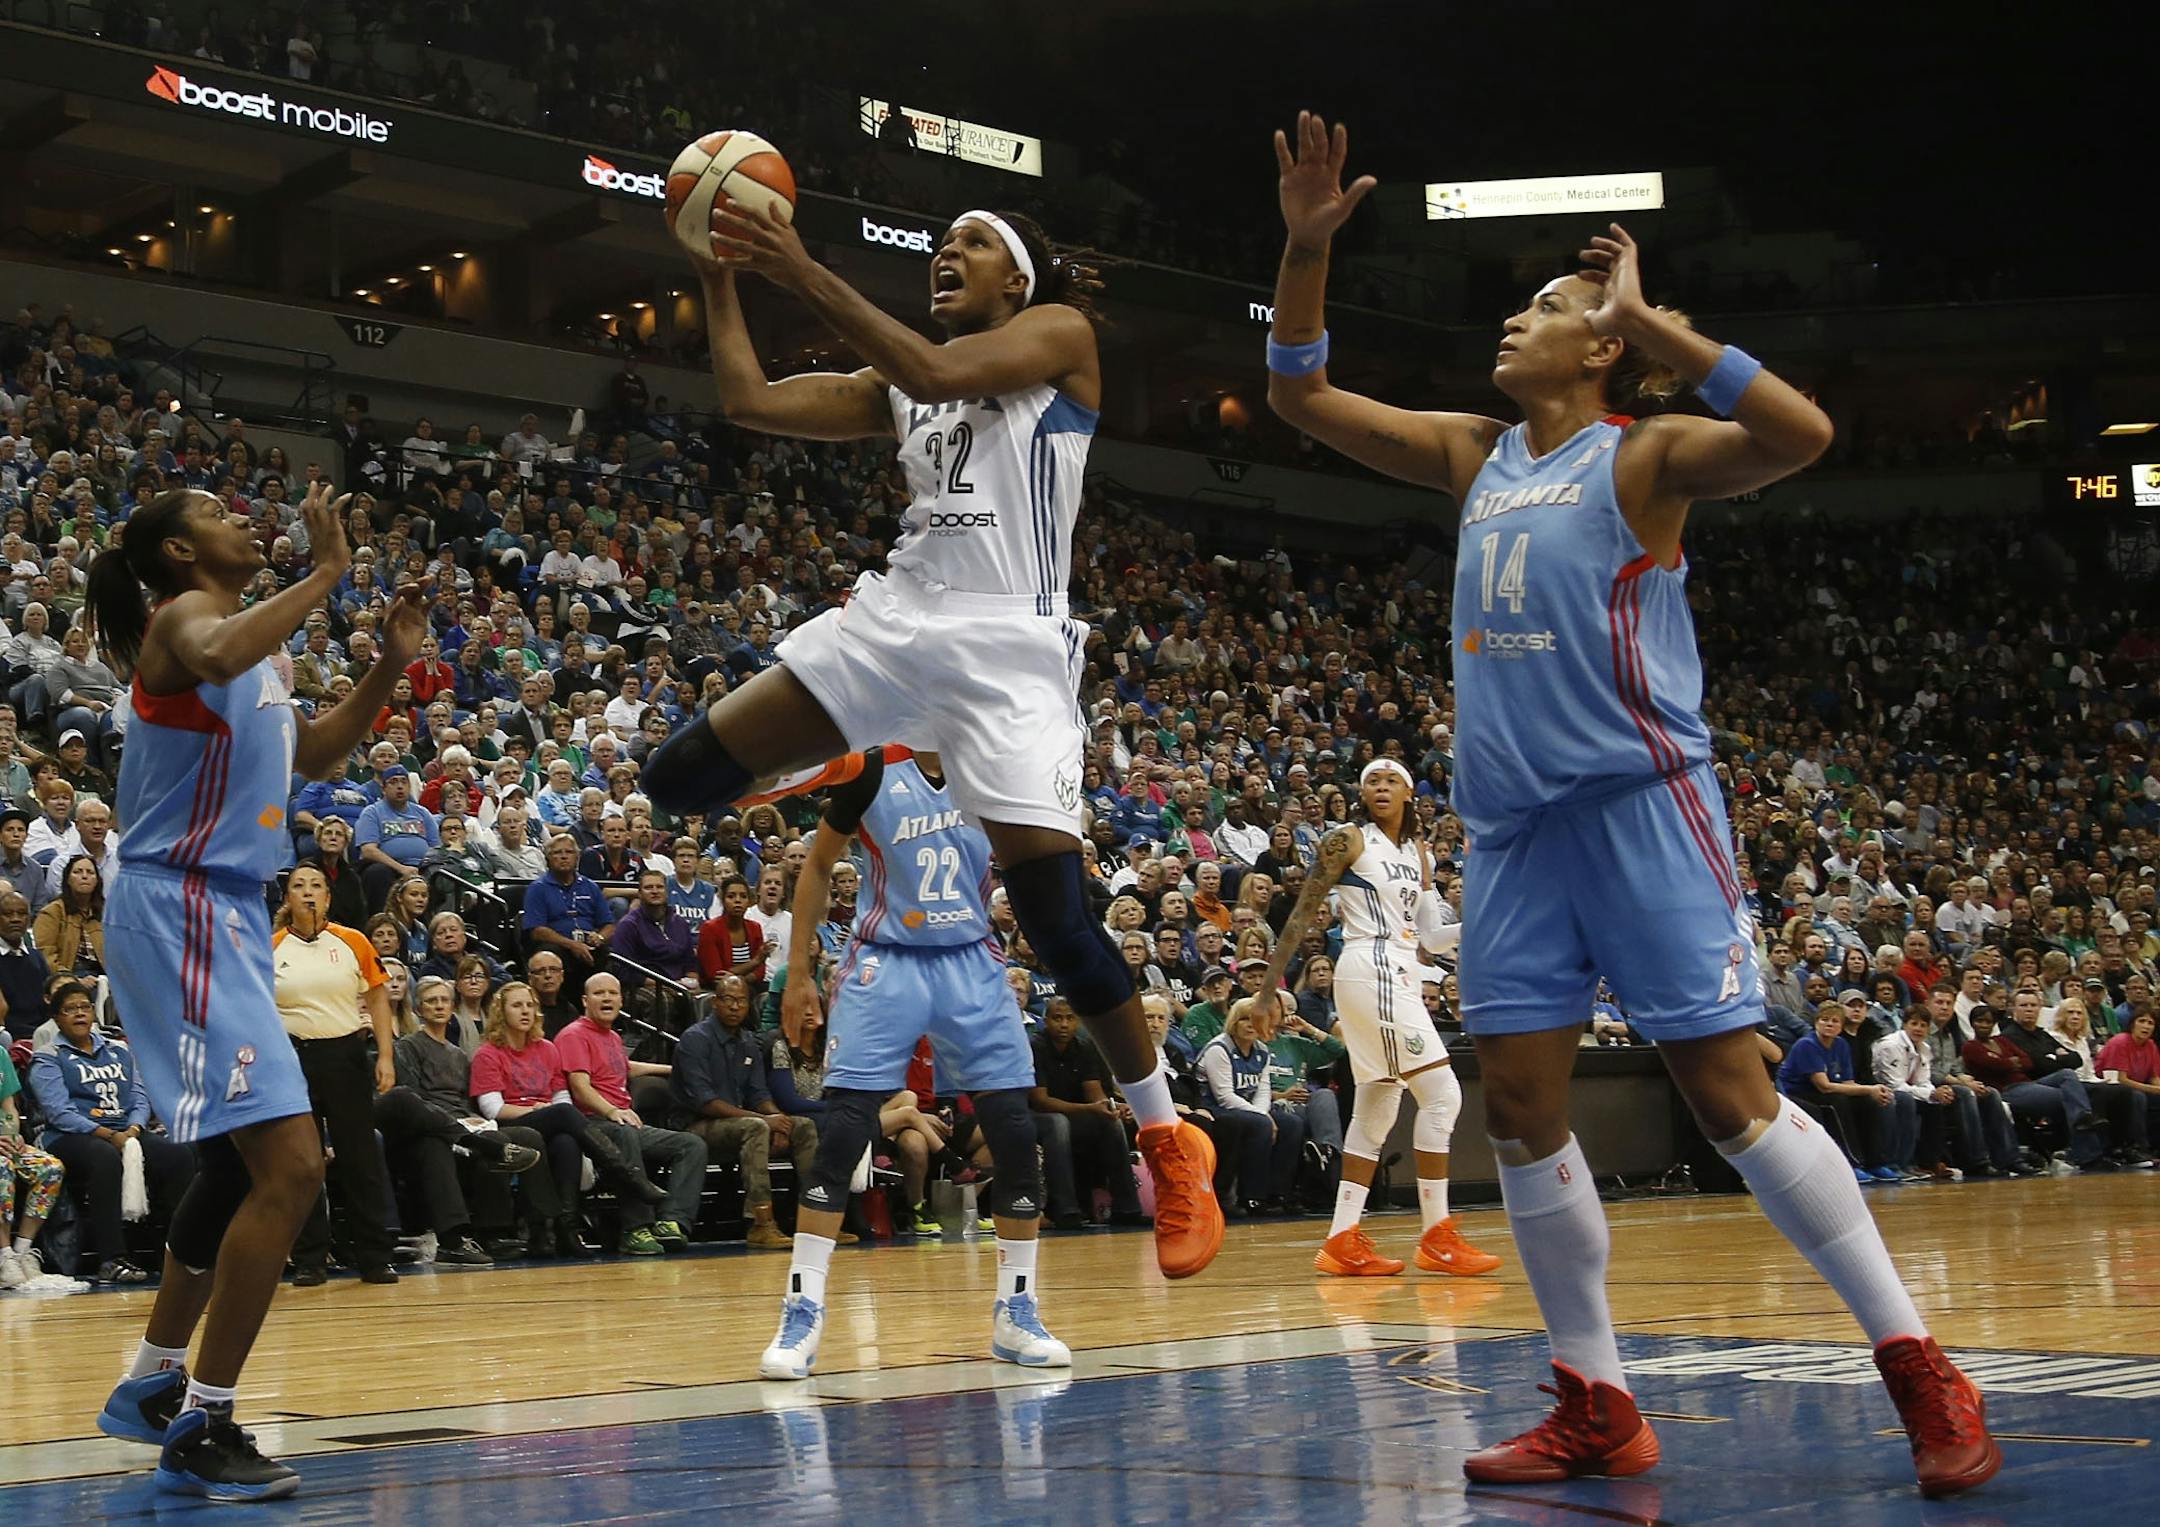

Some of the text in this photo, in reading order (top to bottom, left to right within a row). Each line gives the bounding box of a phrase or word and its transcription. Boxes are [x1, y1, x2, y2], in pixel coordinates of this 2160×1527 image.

[179, 76, 389, 143] boost mobile
[878, 109, 941, 137] FATED
[584, 159, 666, 199] boost
[1473, 187, 1651, 206] Hennepin County Medical Center
[862, 217, 933, 253] boost
[353, 324, 385, 345] 112
[2066, 474, 2118, 499] 7:46
[929, 510, 998, 528] boost
[1464, 484, 1583, 526] ATLANTA
[1481, 532, 1530, 614] 14
[1486, 629, 1557, 651] boost
[916, 846, 961, 902] 22
[926, 906, 974, 924] boost
[95, 1081, 120, 1111] 33
